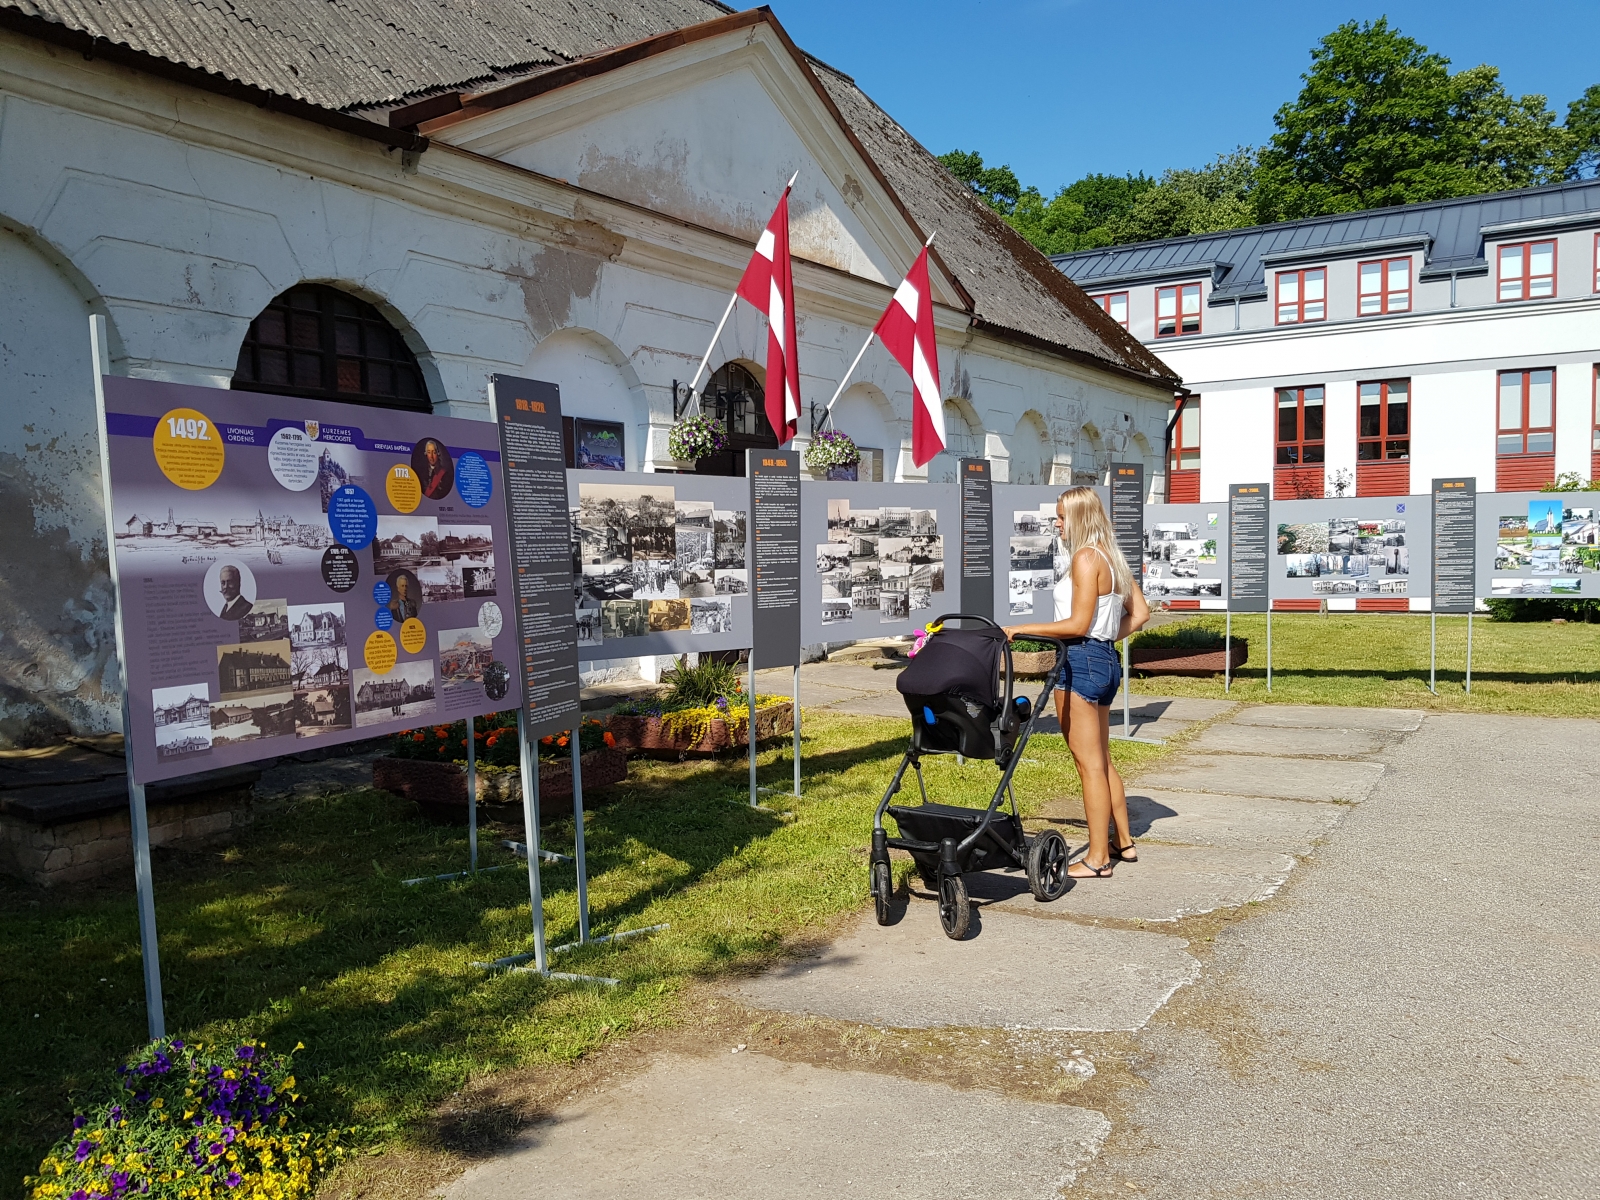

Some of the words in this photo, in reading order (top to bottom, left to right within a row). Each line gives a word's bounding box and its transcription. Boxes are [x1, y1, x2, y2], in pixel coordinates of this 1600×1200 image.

[166, 417, 212, 441] 1492.
[322, 427, 352, 436] KURZEMES
[227, 434, 255, 443] ORDENIS
[394, 467, 411, 479] 1773.
